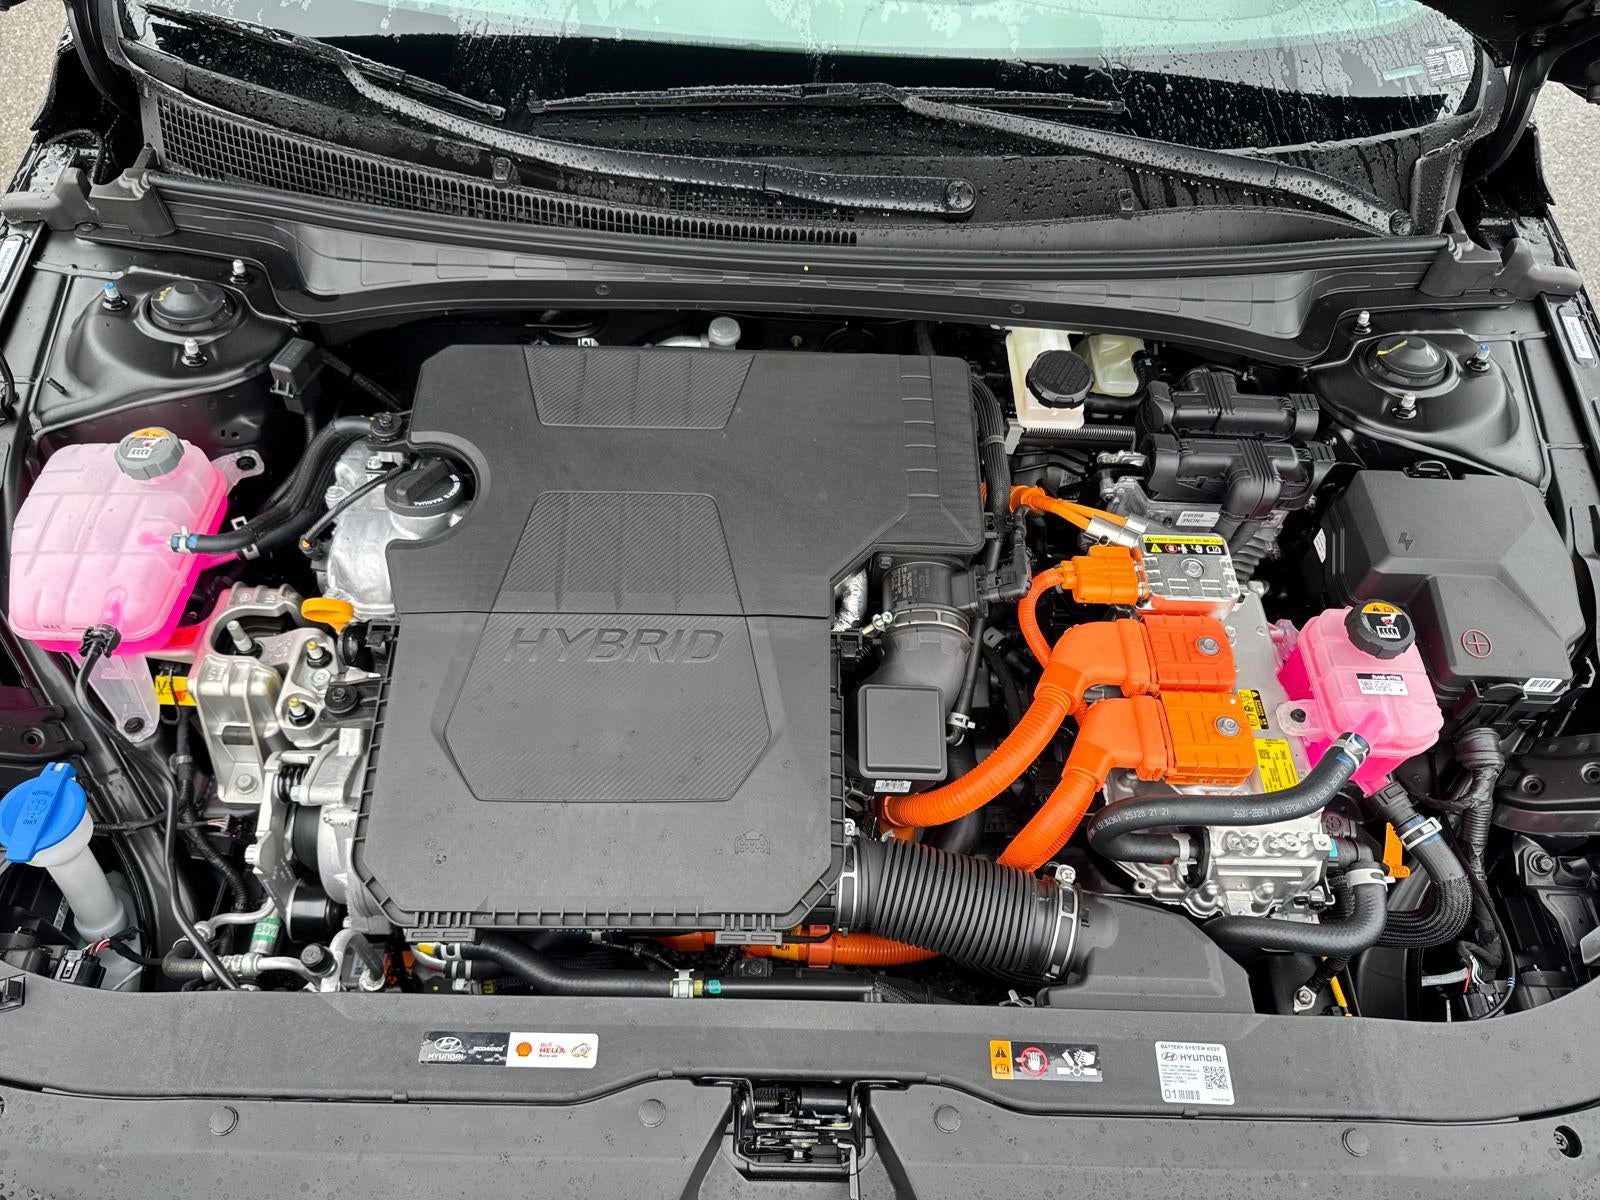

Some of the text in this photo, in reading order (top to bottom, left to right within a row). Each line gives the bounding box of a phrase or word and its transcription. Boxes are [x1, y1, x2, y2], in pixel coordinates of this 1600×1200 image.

[413, 498, 443, 506] MANUAL
[503, 628, 724, 663] HYBRID
[539, 1045, 567, 1054] HELIX
[428, 1053, 464, 1062] HYUNDAI
[1180, 1054, 1221, 1062] HYUNDAI
[1164, 1088, 1177, 1099] 01
